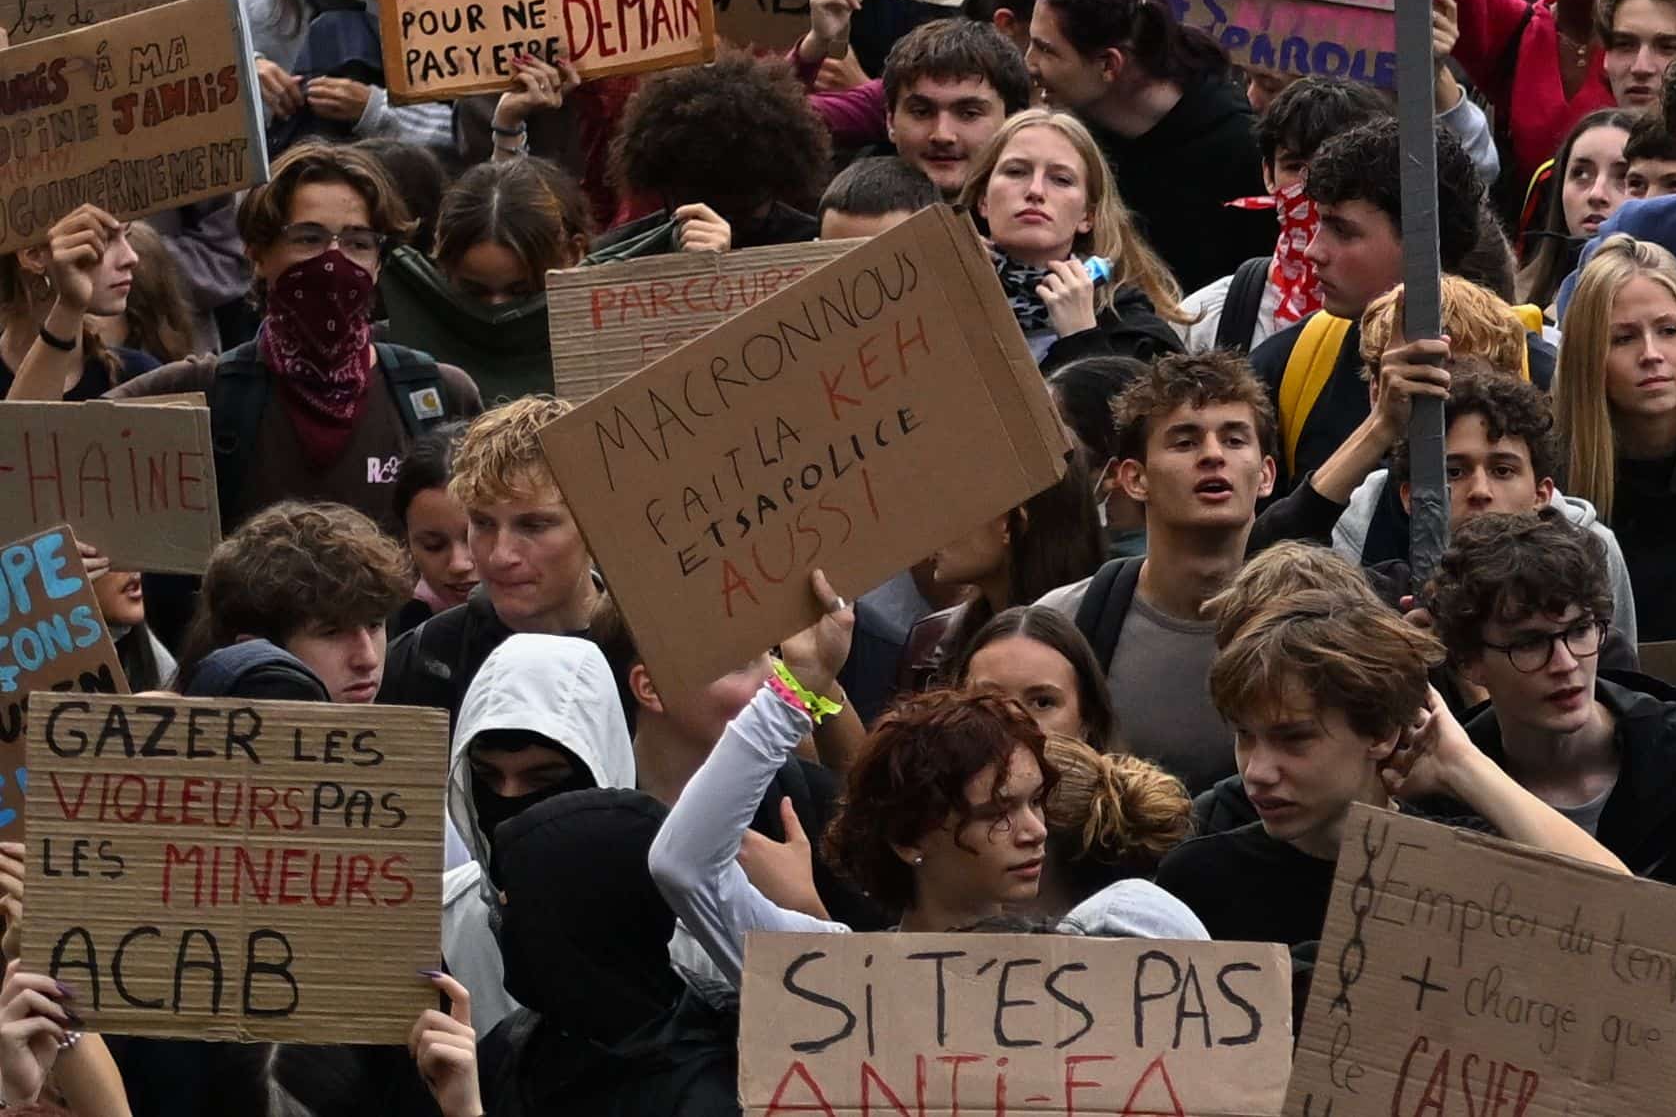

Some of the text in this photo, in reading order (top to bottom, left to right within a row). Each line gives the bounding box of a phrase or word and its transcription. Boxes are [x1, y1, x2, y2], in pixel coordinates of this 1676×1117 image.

[401, 3, 488, 40] POUR
[502, 0, 547, 32] NE
[128, 34, 191, 87] MA
[818, 316, 931, 421] KEH
[718, 467, 880, 618] AUSSI
[45, 700, 263, 765] GAZER
[293, 729, 385, 767] LES
[50, 770, 304, 833] VIOLEURS
[311, 781, 408, 830] PAS
[42, 838, 415, 908] LES MINEURS
[1557, 906, 1595, 957] du
[48, 925, 301, 1018] ACAB
[906, 949, 1095, 1050] T'ES
[1132, 949, 1263, 1050] PAS
[1328, 1021, 1367, 1095] le
[1601, 1011, 1663, 1082] que
